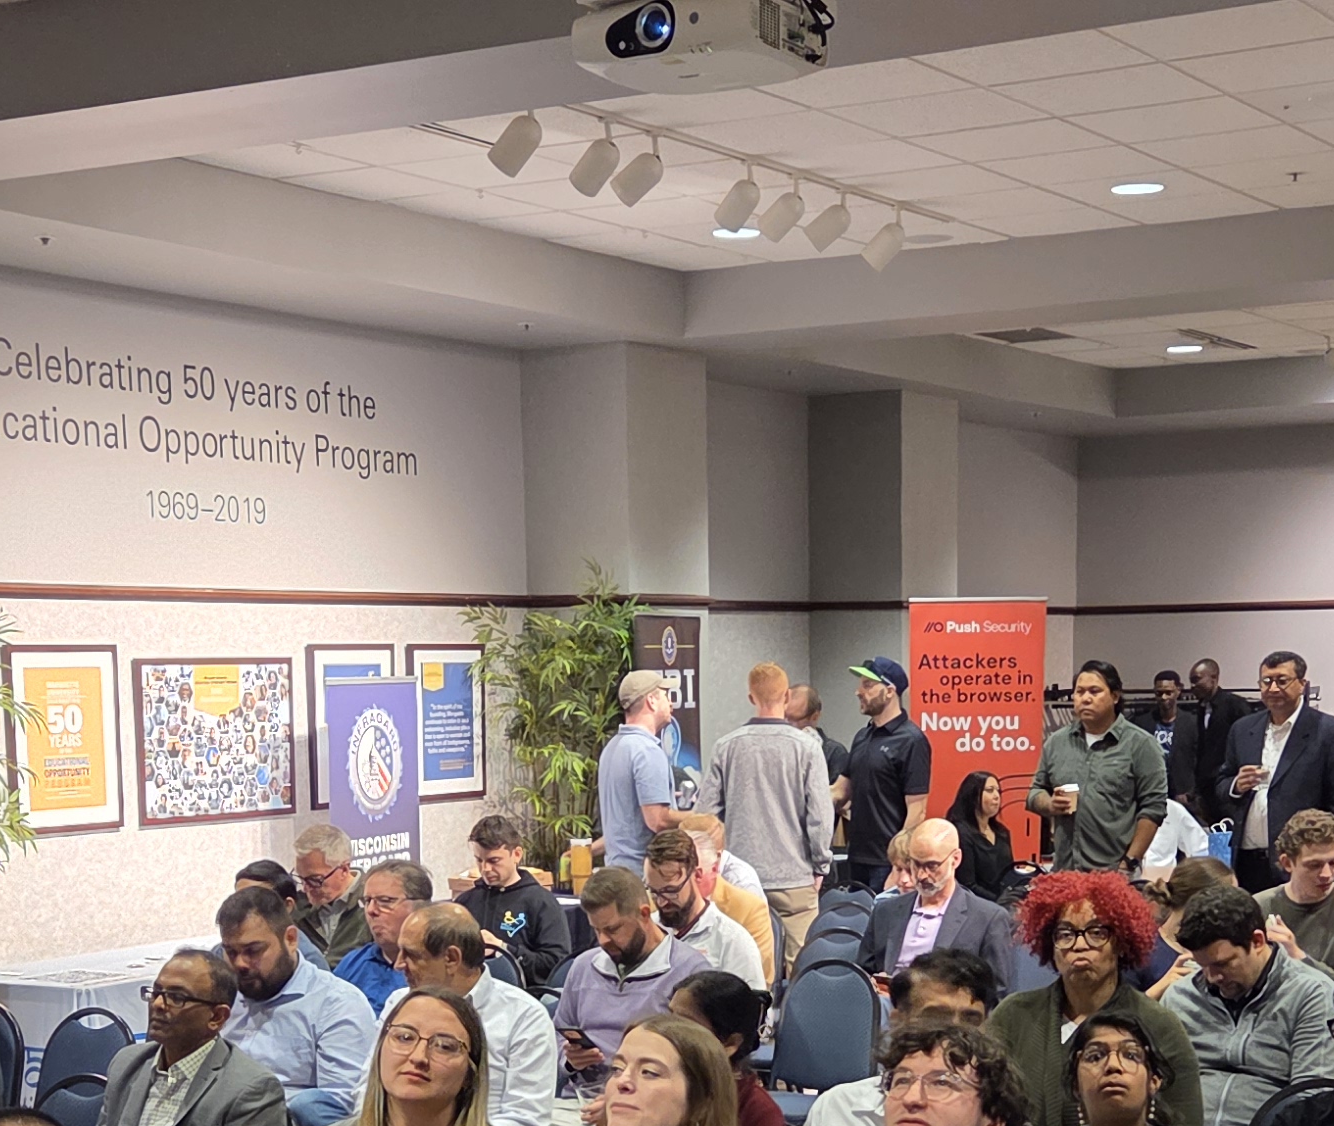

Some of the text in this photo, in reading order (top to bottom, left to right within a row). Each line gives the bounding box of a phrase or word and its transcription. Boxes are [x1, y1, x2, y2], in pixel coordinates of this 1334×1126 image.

[183, 365, 215, 401] 50
[224, 376, 297, 412] years
[306, 381, 331, 415] of
[338, 384, 377, 420] the
[139, 415, 306, 473] Opportunity
[314, 433, 419, 480] Program
[946, 620, 1032, 636] Push Security
[918, 652, 1017, 670] Attackers
[940, 669, 1033, 690] operate in
[921, 688, 1036, 704] the browser.
[47, 704, 83, 734] 50
[921, 711, 1019, 736] Now you
[48, 733, 83, 749] YEARS
[955, 732, 1036, 752] do too.
